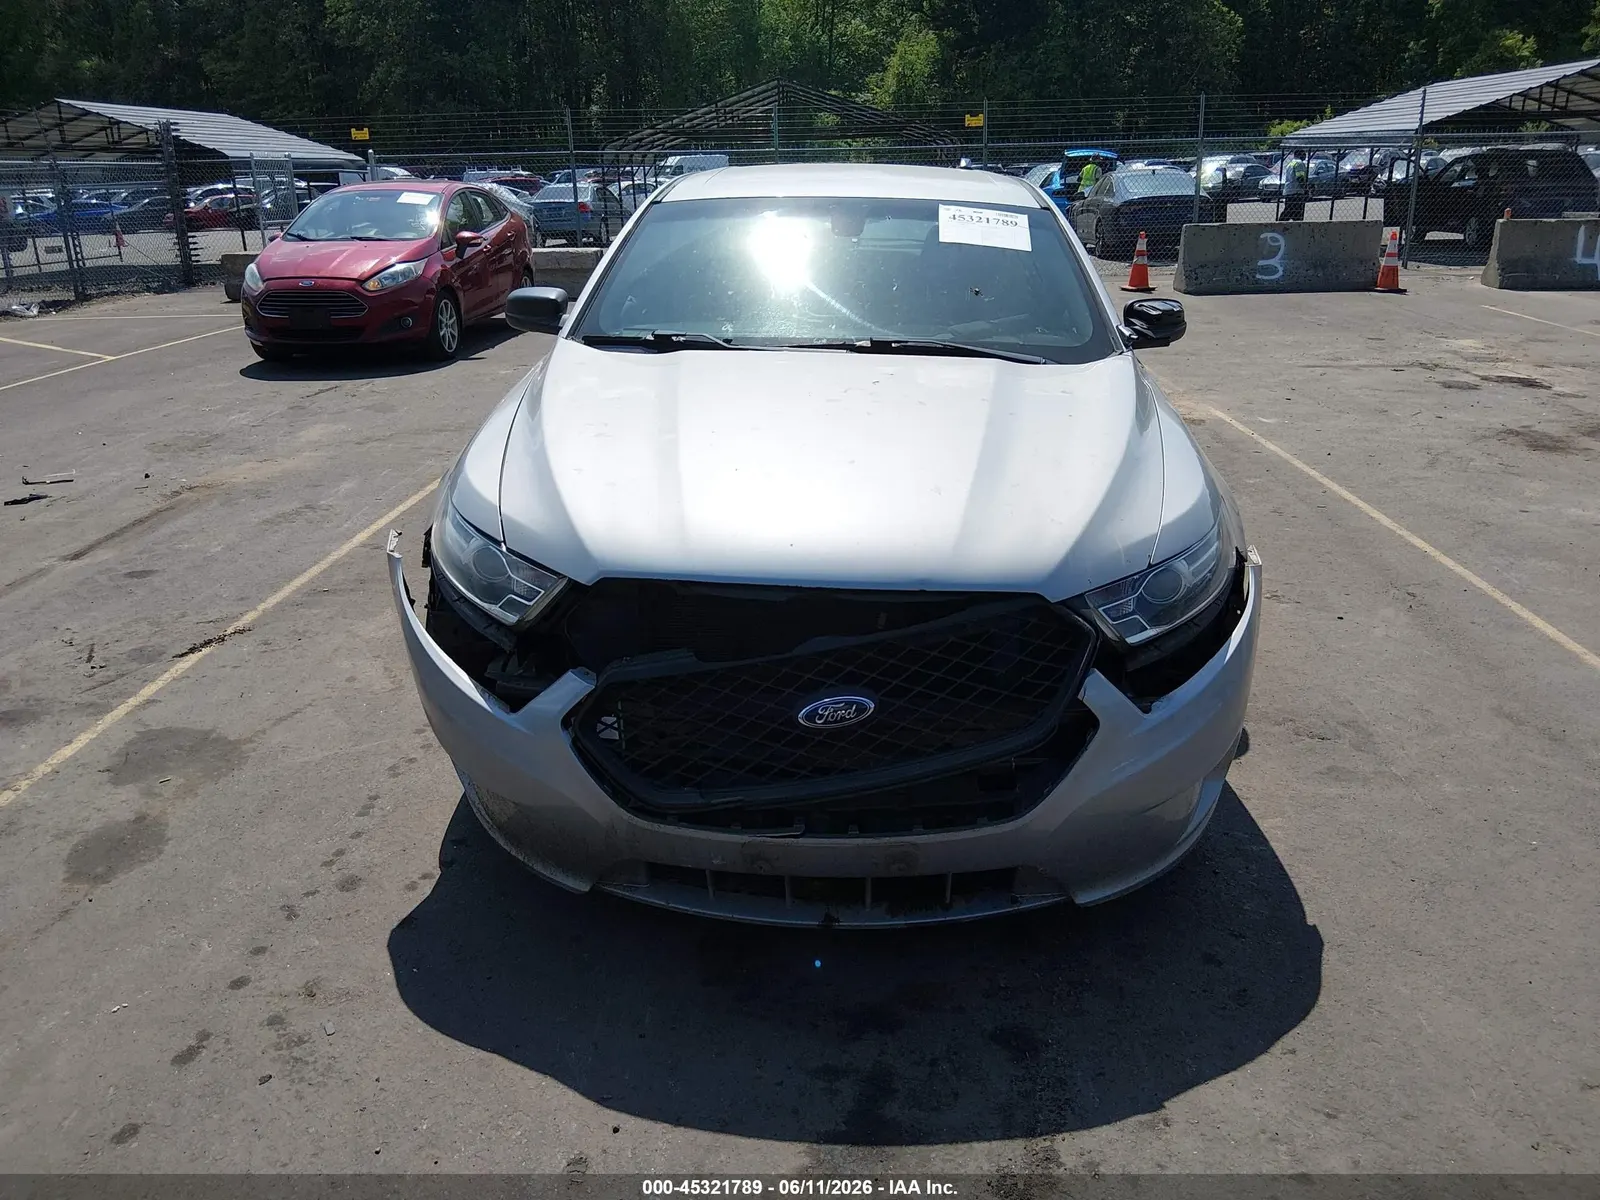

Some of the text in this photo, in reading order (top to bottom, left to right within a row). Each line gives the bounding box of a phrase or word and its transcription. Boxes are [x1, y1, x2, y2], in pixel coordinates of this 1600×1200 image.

[948, 214, 1018, 227] 45321789
[1256, 232, 1285, 280] 3
[1576, 224, 1600, 281] 4
[815, 703, 857, 723] Ford
